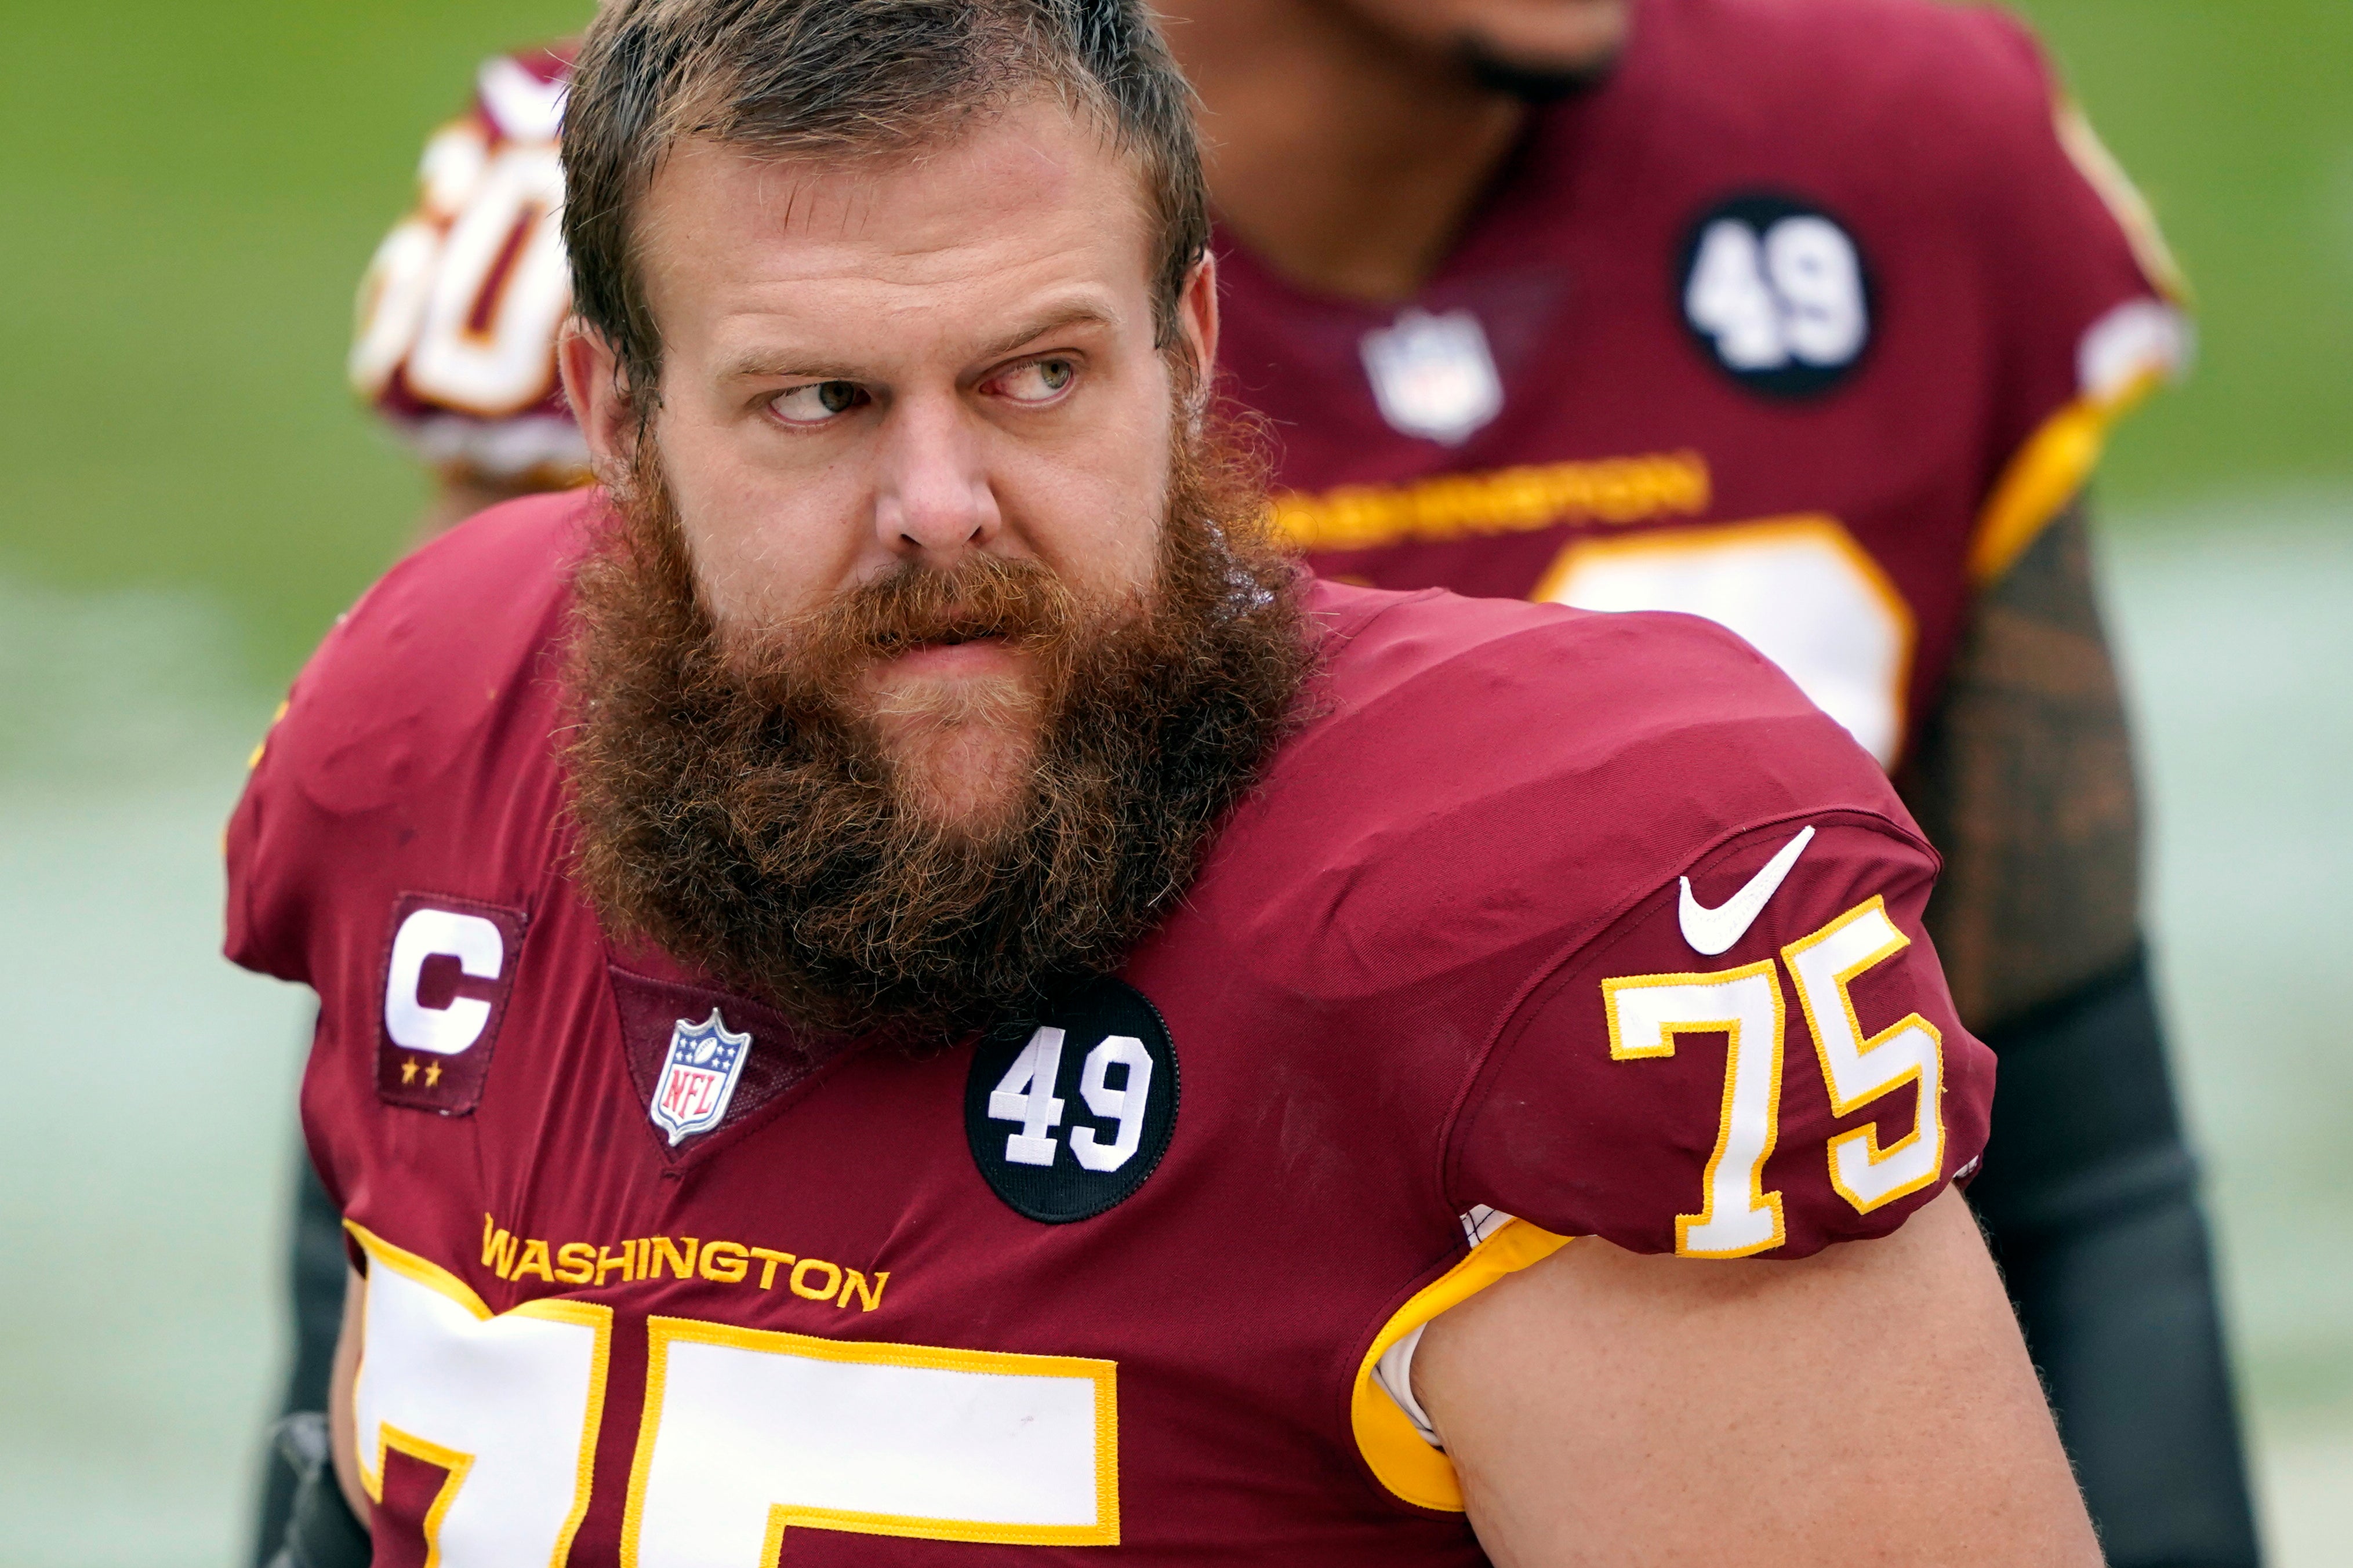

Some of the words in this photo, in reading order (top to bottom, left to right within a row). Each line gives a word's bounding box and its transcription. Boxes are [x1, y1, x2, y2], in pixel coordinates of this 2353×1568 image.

[1684, 214, 1869, 371] 49
[384, 908, 504, 1055] C
[663, 1070, 715, 1119] NFL
[988, 1025, 1154, 1173] 49
[1600, 894, 1945, 1258] 75
[481, 1212, 891, 1313] WASHINGTON
